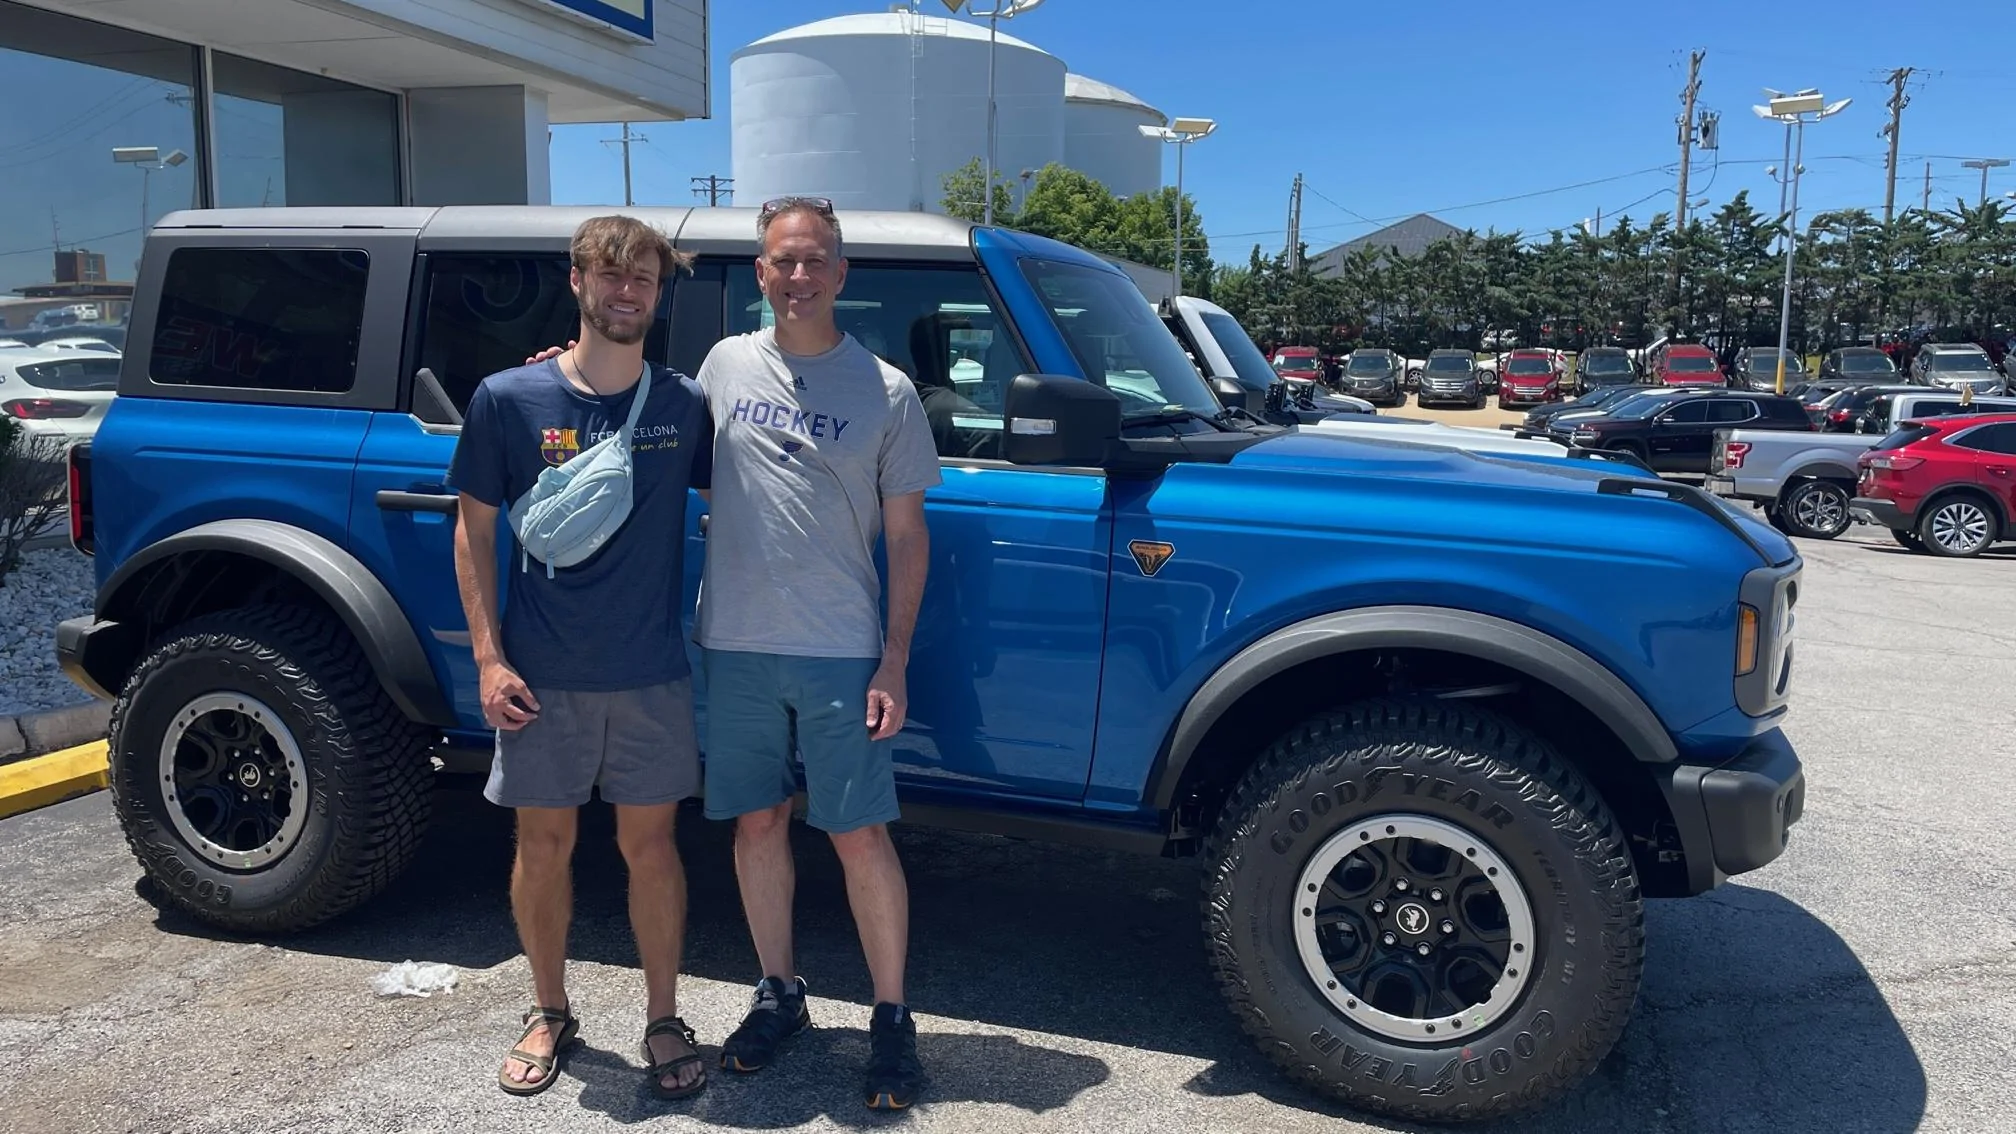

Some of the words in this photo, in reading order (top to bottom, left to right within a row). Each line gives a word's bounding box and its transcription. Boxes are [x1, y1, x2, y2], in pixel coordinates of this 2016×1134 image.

[733, 399, 850, 441] HOCKEY
[590, 425, 678, 443] FCBCELONA
[658, 438, 678, 449] club
